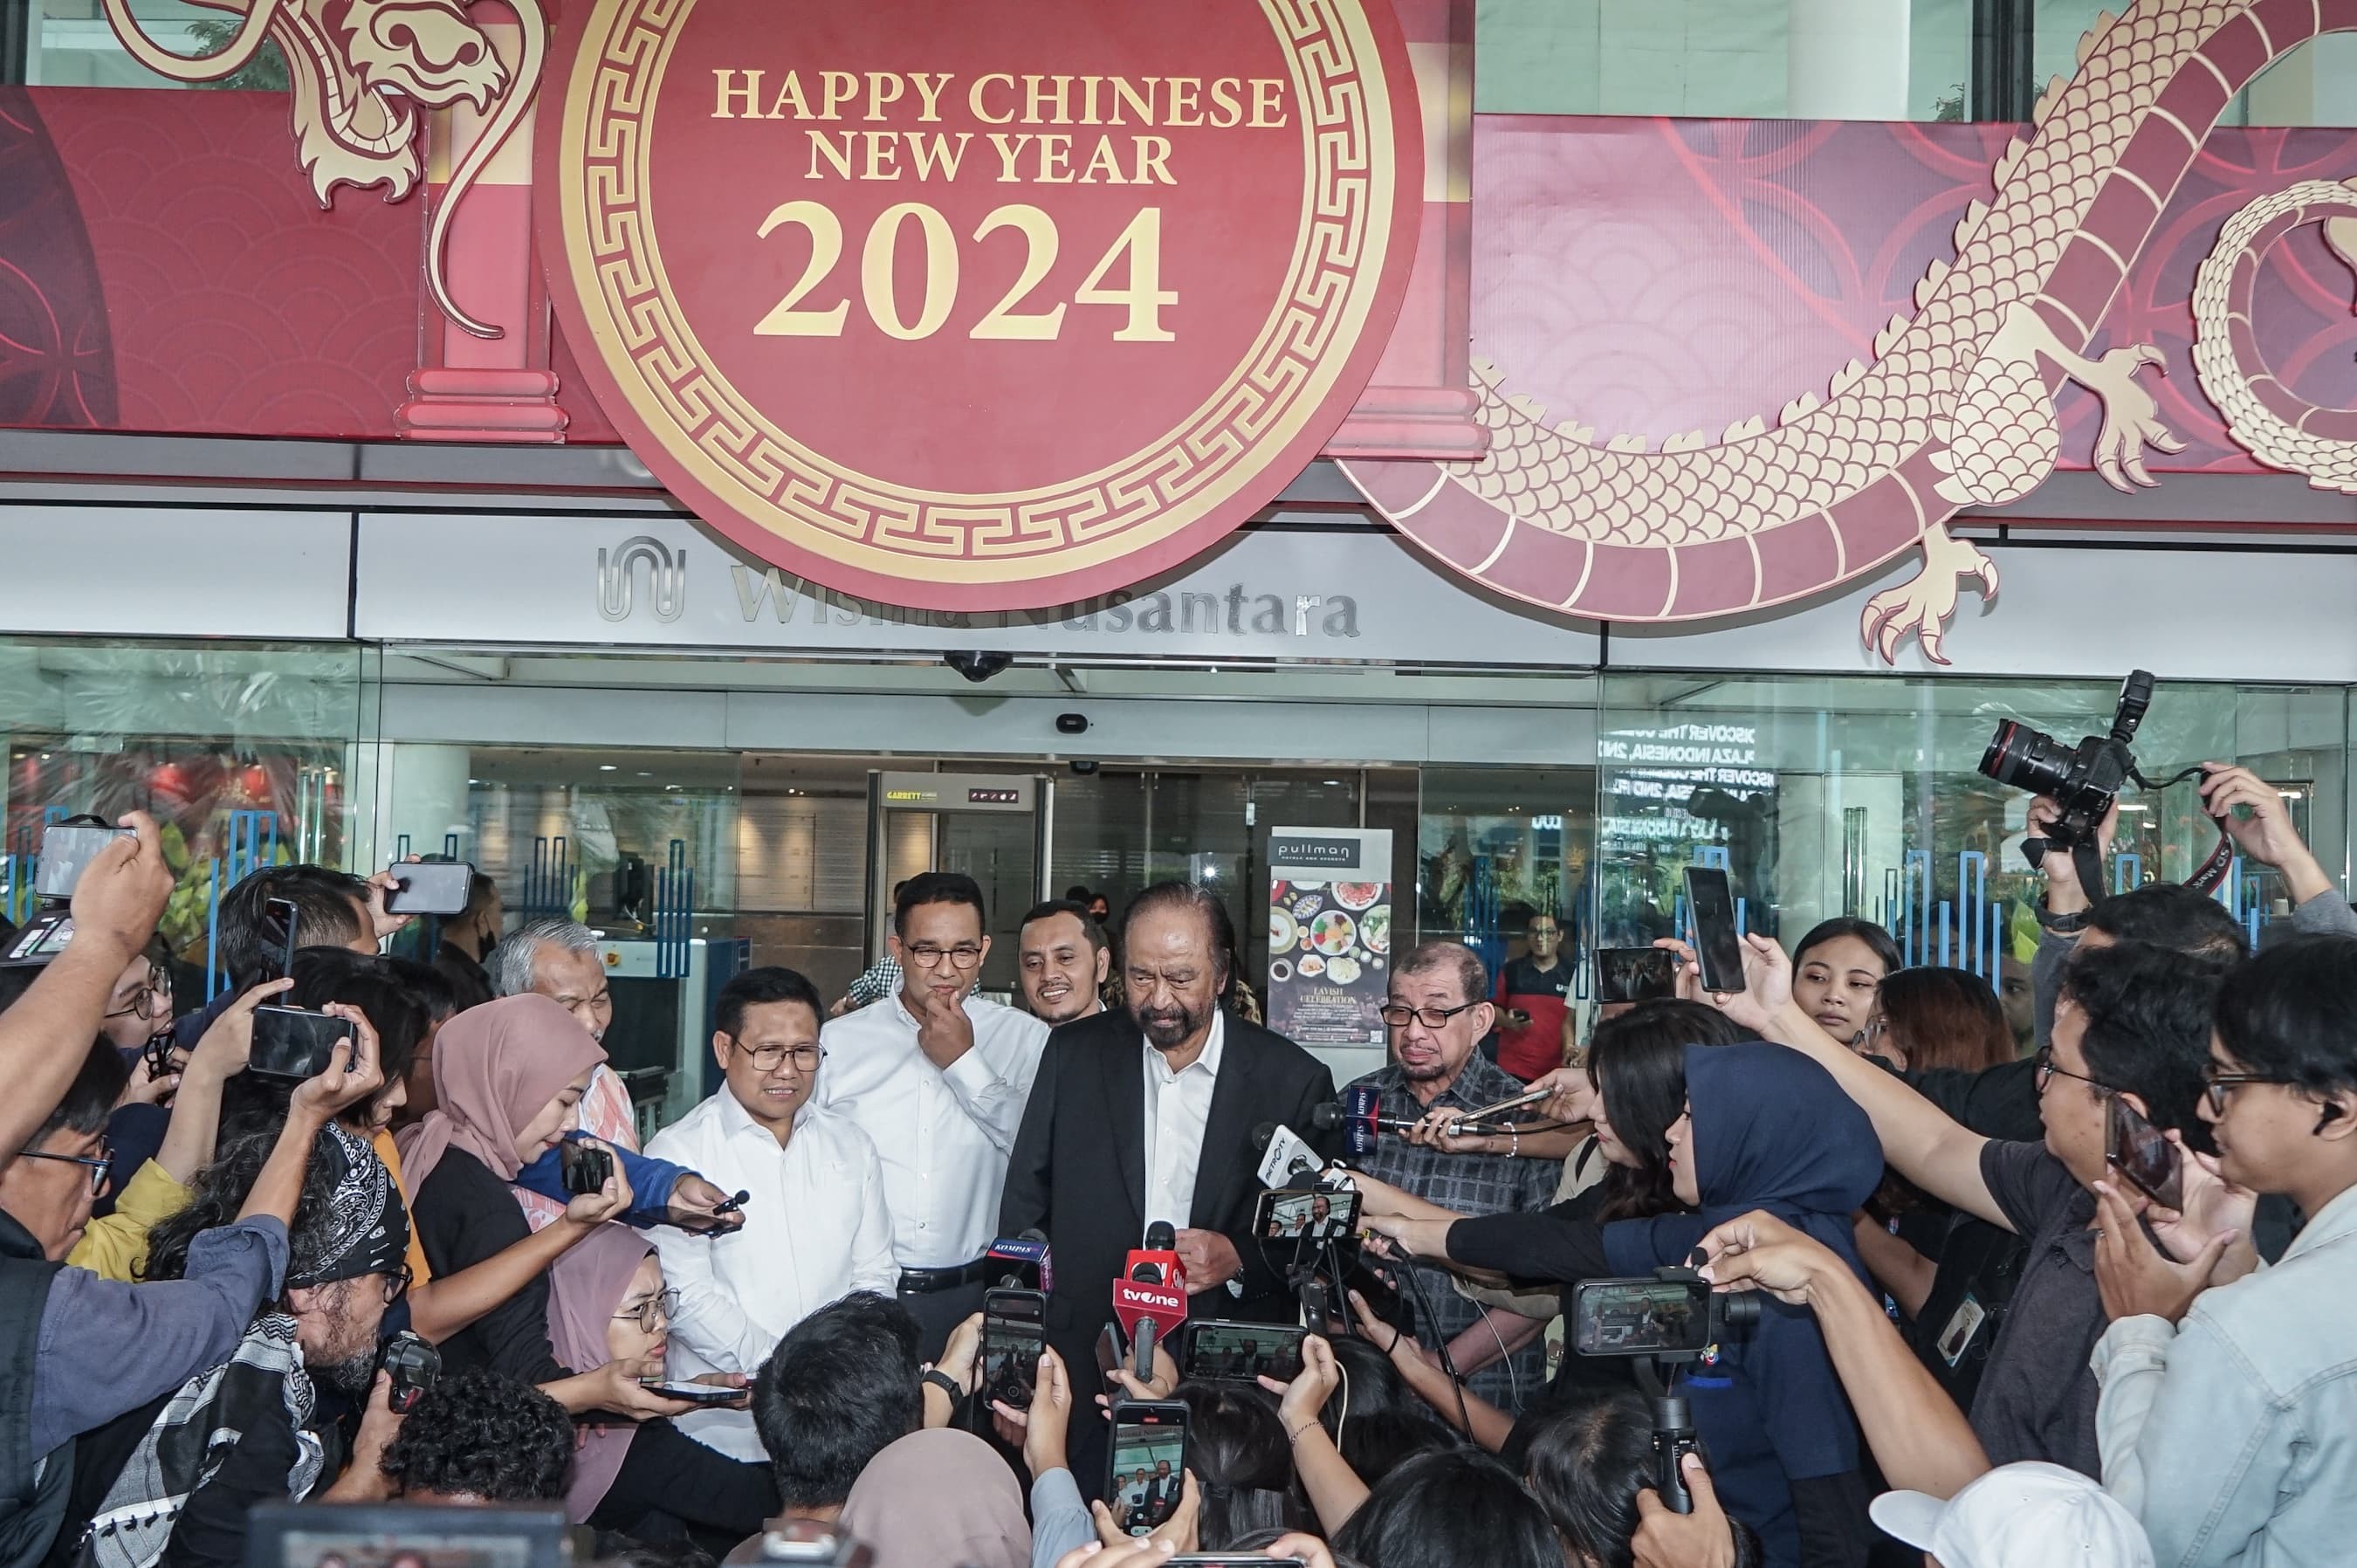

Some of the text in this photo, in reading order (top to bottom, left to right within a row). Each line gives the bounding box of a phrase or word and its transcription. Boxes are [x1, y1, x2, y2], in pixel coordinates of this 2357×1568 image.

[711, 69, 1288, 128] HAPPY CHINESE
[804, 130, 1178, 185] NEW YEAR
[753, 200, 1178, 342] 2024
[1278, 843, 1350, 859] pullman
[994, 1243, 1033, 1254] KOMPAS
